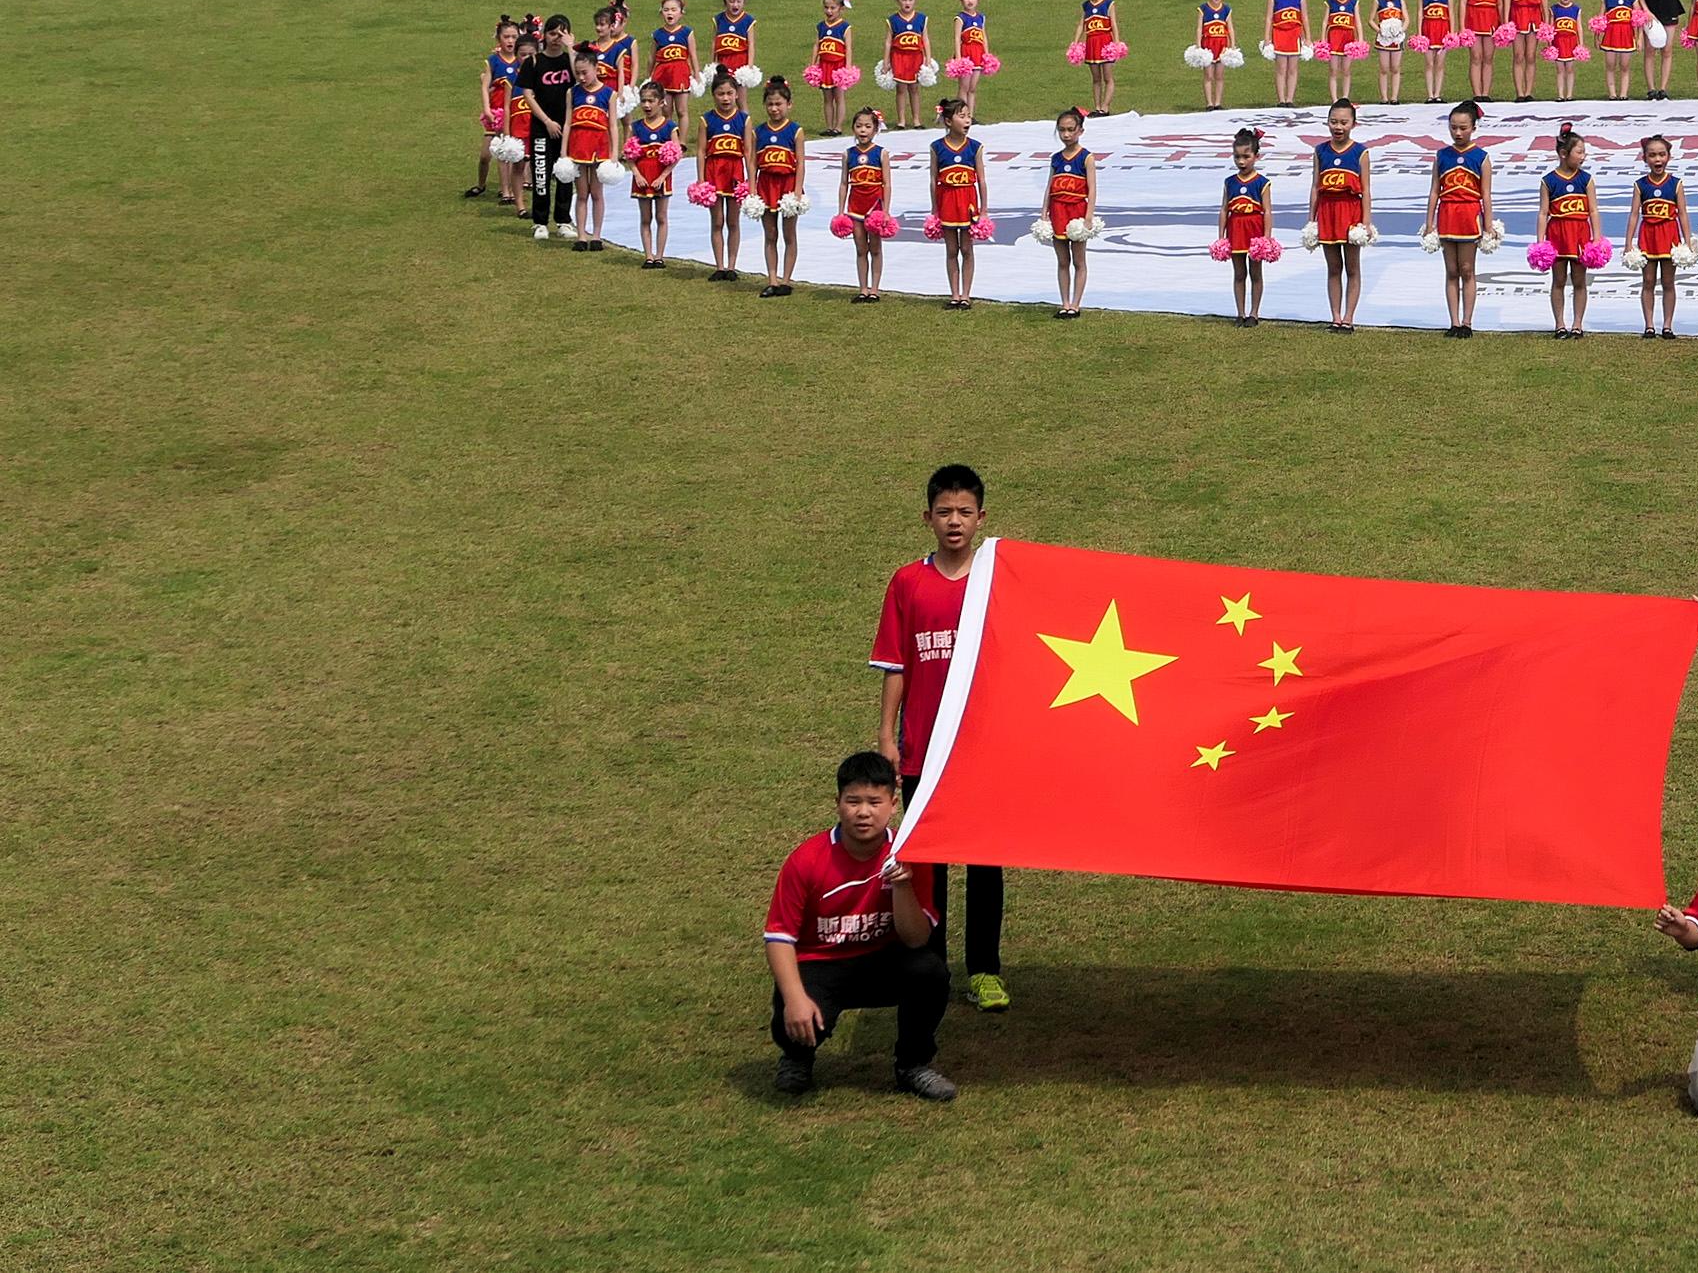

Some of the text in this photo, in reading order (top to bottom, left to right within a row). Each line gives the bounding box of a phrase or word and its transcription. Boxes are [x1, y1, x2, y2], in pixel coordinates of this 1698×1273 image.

[1281, 10, 1297, 20] CCA
[1427, 8, 1444, 17] CCA
[1616, 10, 1632, 19] CCA
[1088, 20, 1104, 29] CCA
[1332, 16, 1351, 26] CCA
[1556, 19, 1574, 28] CCA
[969, 29, 984, 41] CCA
[1208, 25, 1225, 36] CCA
[721, 37, 740, 48] CCA
[899, 35, 919, 45] CCA
[820, 41, 836, 51] CCA
[664, 47, 682, 58] CCA
[542, 69, 570, 85] CCA
[576, 108, 598, 120] CCA
[715, 139, 738, 150] CCA
[765, 151, 786, 163] CCA
[536, 158, 546, 196] ENERGY
[946, 172, 968, 184] CCA
[1322, 173, 1345, 185] CCA
[1444, 171, 1472, 185] CCA
[1053, 178, 1076, 189] CCA
[1560, 200, 1584, 212] CCA
[1646, 203, 1669, 217] CCA
